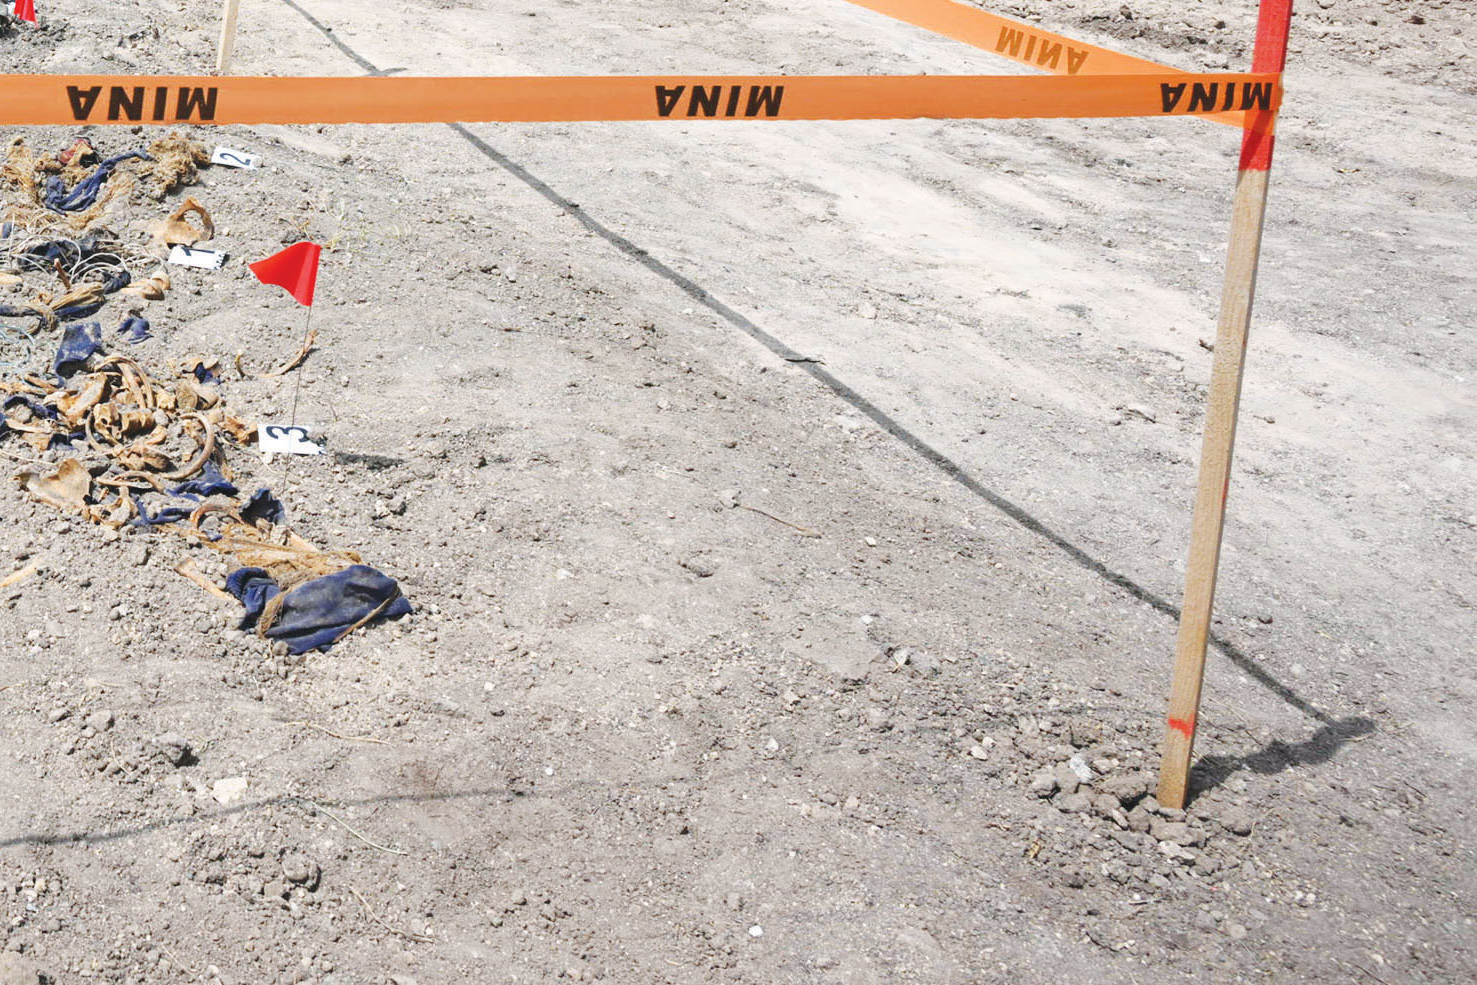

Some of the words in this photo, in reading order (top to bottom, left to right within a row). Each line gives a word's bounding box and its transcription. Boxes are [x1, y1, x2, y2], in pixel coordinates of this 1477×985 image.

[66, 85, 218, 121] MINA
[655, 85, 785, 117] MINA
[1160, 82, 1273, 113] MINA
[219, 152, 252, 166] 2
[265, 425, 309, 443] 3
